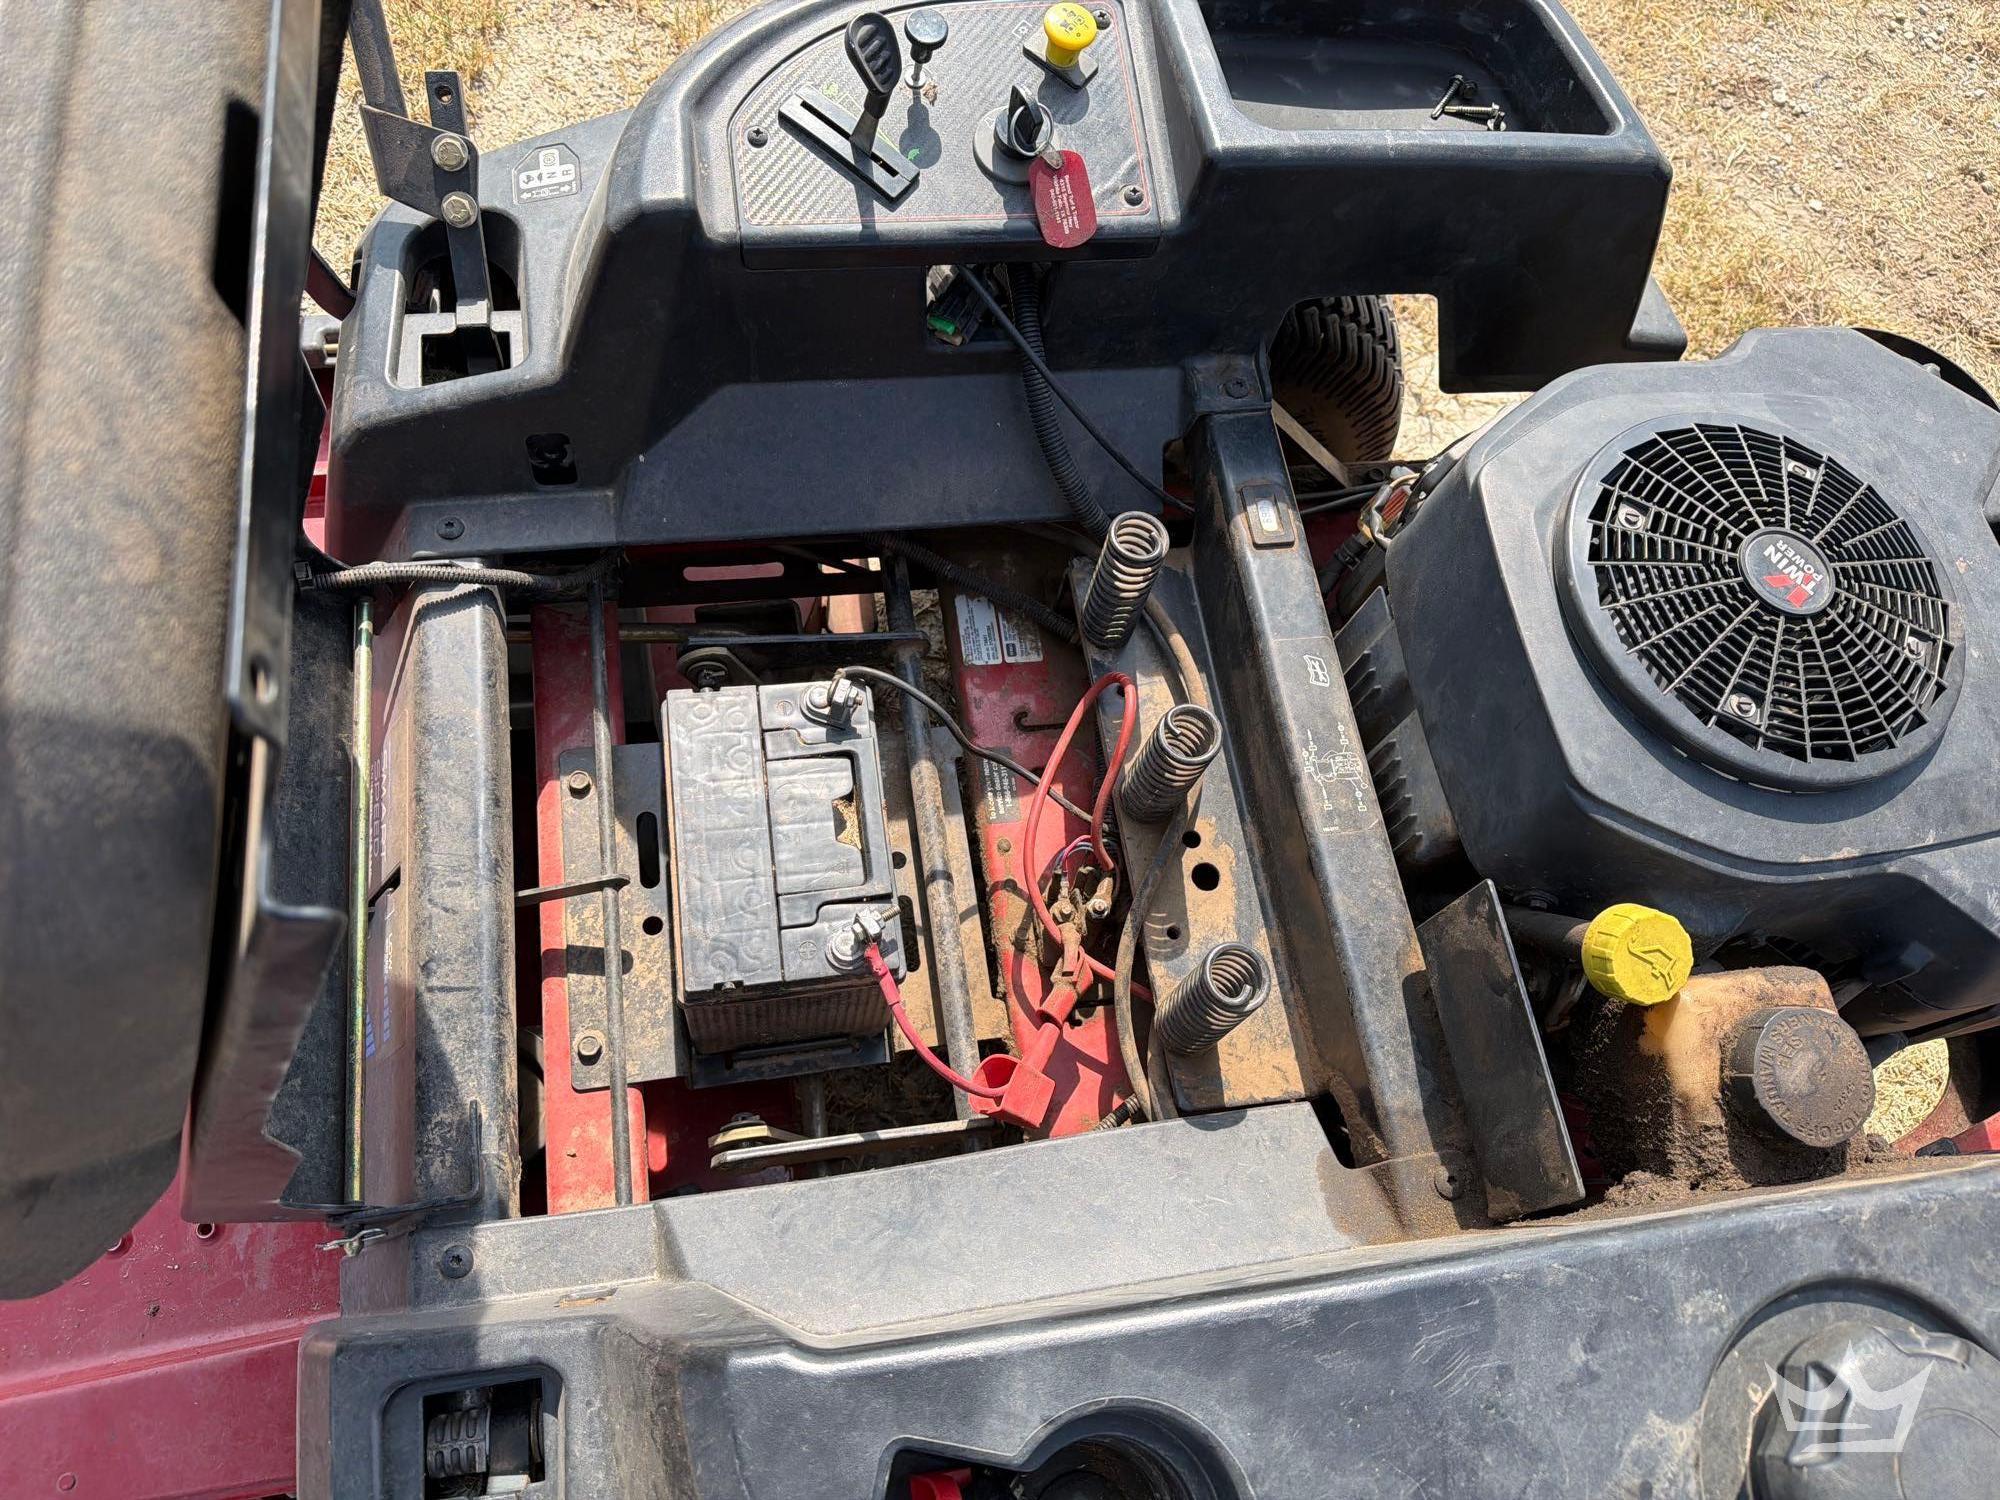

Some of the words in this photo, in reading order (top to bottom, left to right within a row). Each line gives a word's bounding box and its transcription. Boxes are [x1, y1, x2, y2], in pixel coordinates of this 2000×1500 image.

[1763, 545, 1815, 596] TWIN
[1776, 540, 1823, 582] POWER
[373, 758, 382, 858] SPEED
